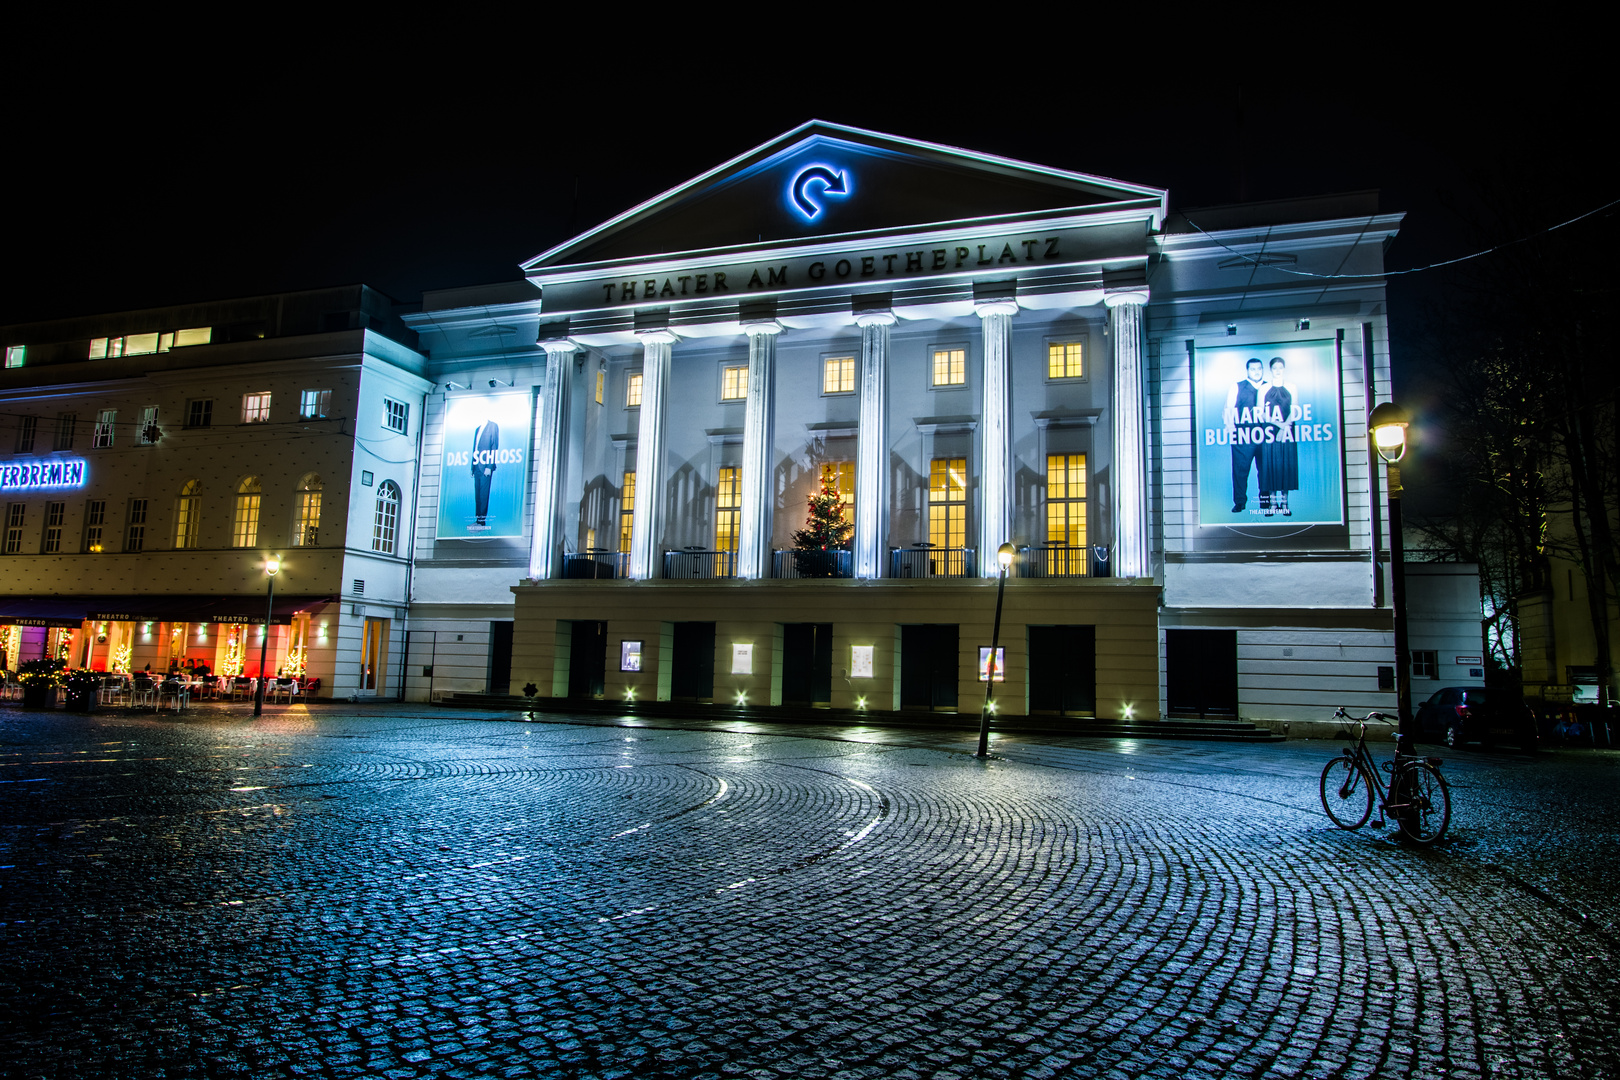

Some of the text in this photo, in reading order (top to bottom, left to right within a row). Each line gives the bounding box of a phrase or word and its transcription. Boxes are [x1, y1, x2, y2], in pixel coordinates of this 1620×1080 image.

[603, 236, 1060, 300] THEATER AM GOETHEPLATZ
[1223, 401, 1312, 424] MARÍA DE
[1205, 423, 1333, 446] BUENOS AIRES
[446, 448, 523, 467] DAS SCHLOSS
